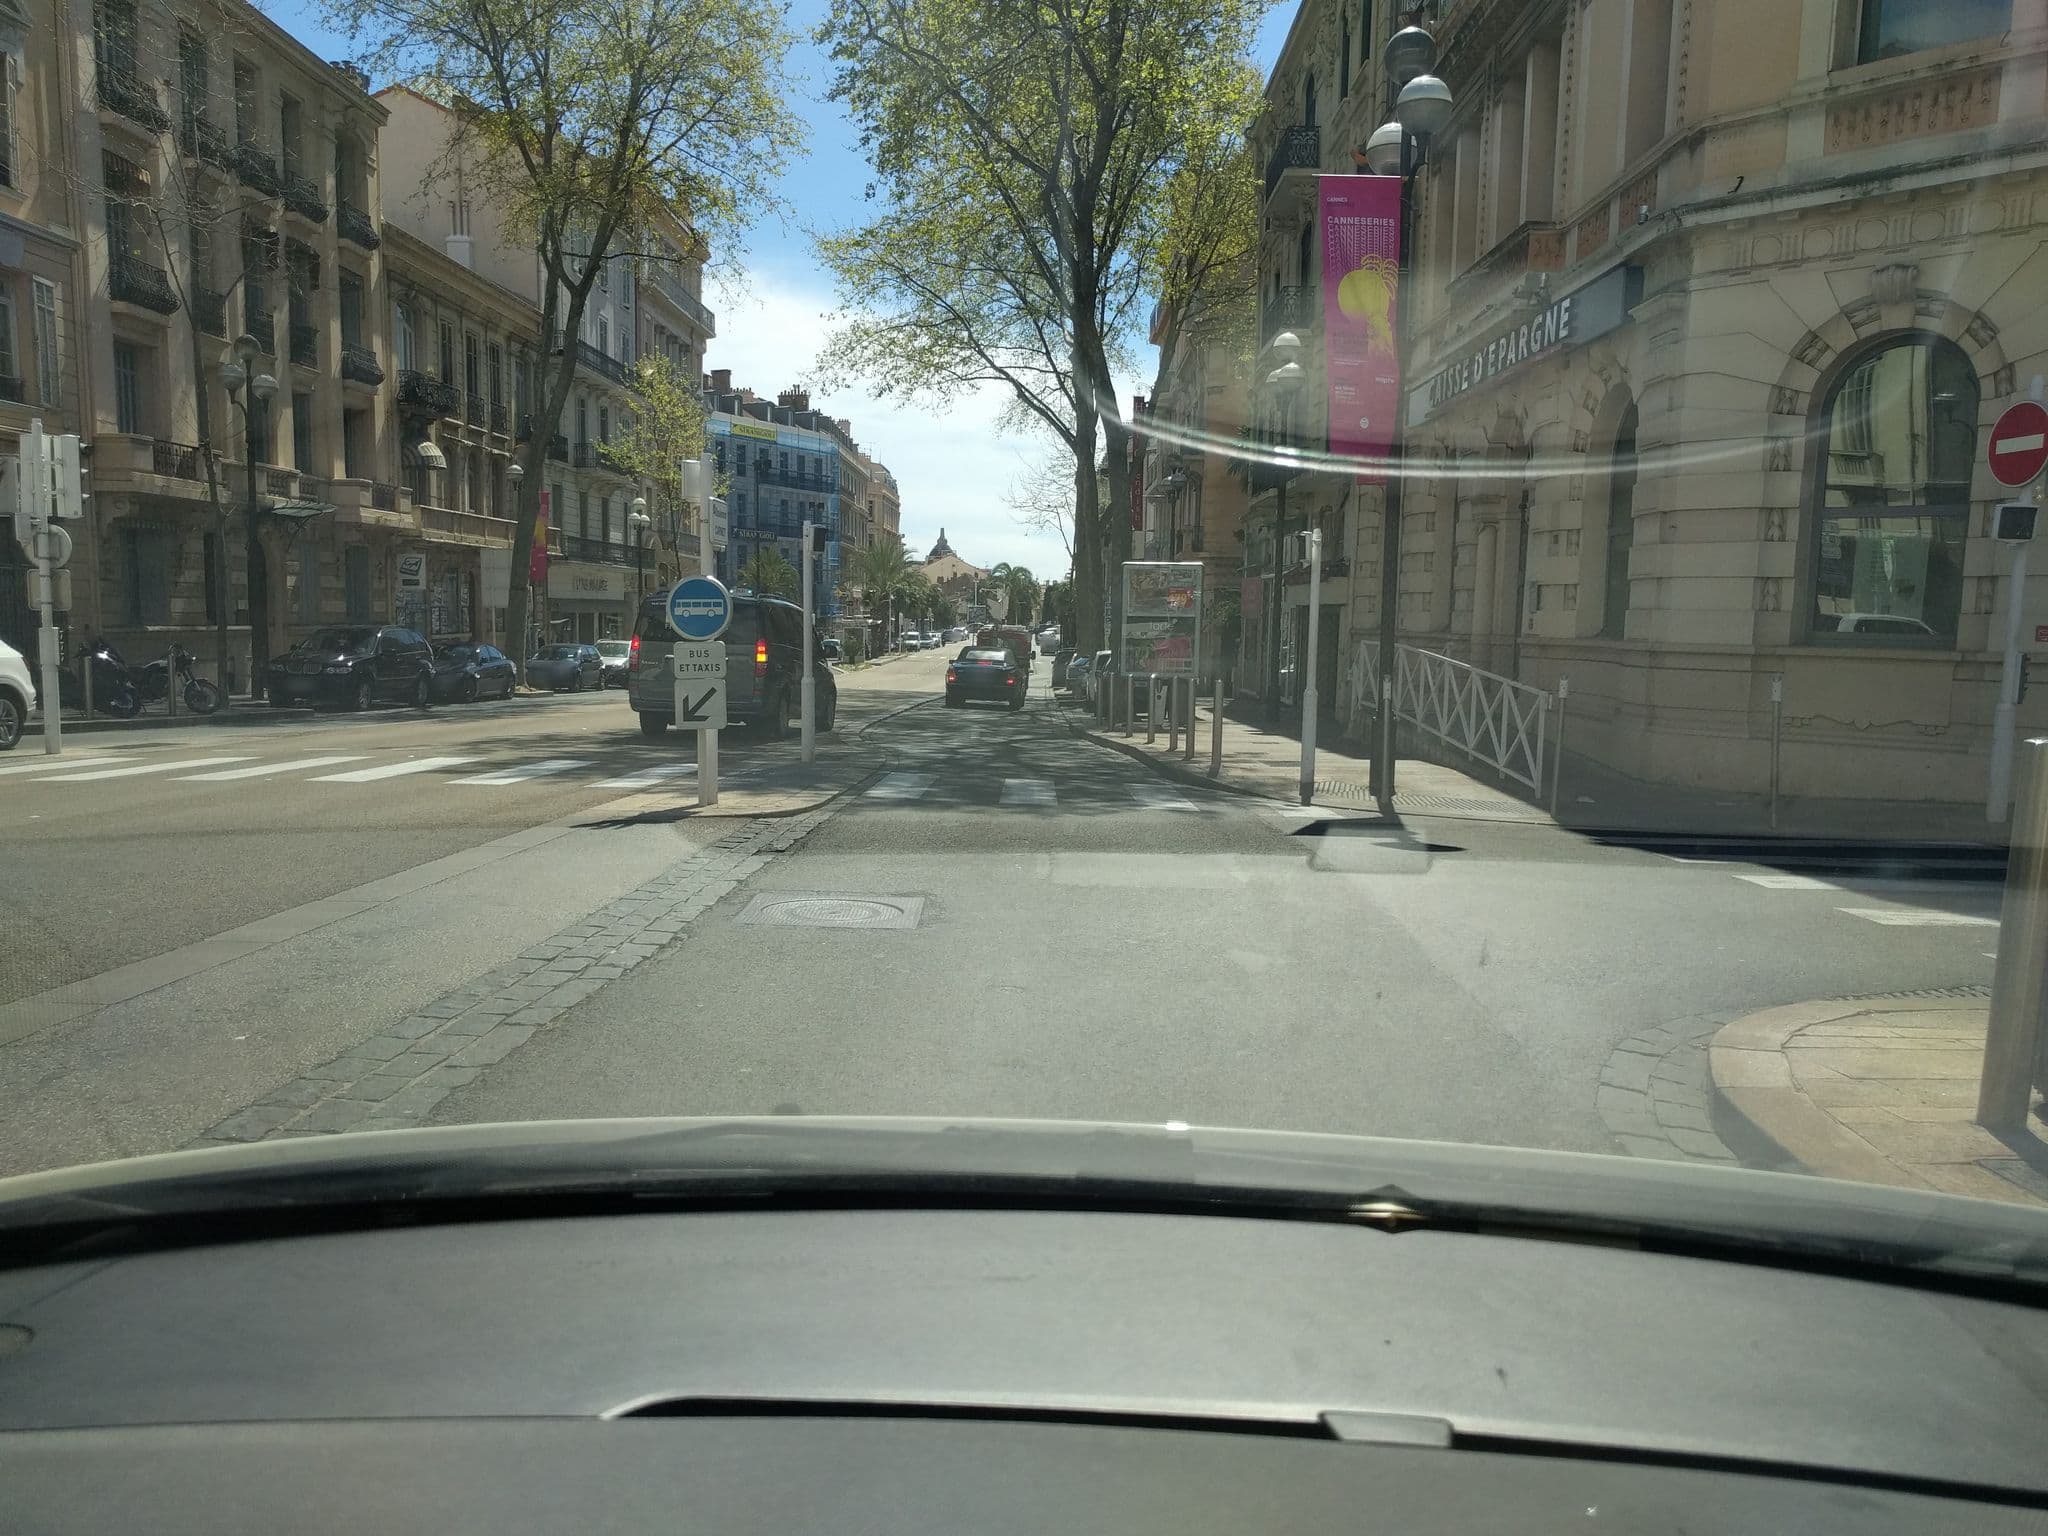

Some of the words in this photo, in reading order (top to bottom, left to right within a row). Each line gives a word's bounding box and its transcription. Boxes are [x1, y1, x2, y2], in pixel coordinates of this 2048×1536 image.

[1327, 216, 1395, 226] CANNESERIES
[1424, 357, 1470, 408] CAISSE
[689, 649, 710, 658] BUS
[679, 663, 690, 672] ET
[692, 663, 721, 672] TAXIS
